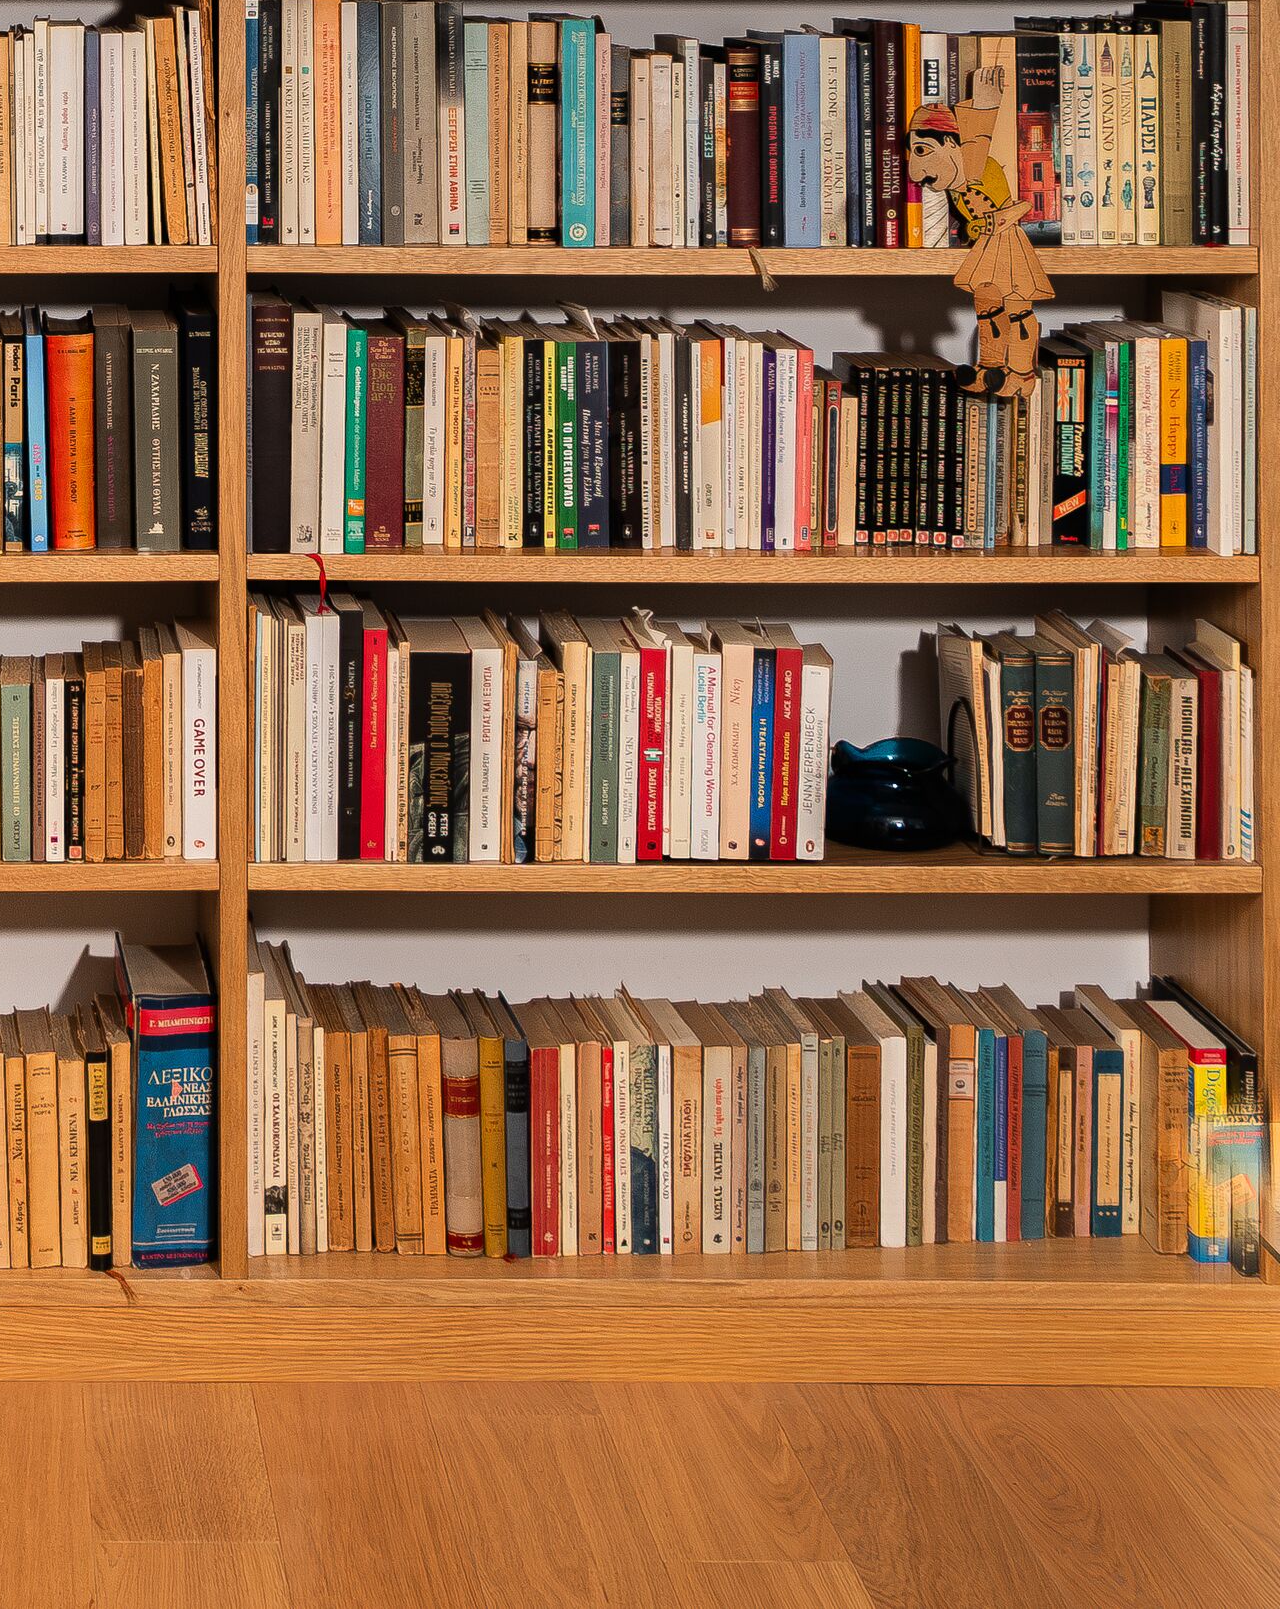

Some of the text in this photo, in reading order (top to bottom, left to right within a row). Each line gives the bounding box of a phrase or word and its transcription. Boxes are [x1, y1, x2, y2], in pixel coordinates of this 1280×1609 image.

[928, 60, 937, 94] PIPER
[1078, 85, 1093, 138] ΡΩΜΗ
[1102, 82, 1115, 151] ΛΟΝΔΙΝΟ
[1142, 97, 1156, 153] ΠΑΡΙΣΙ
[449, 107, 458, 211] ΕΞΕΓΕΡΣΗ ΣΤΗΝ ΑΘΗΝΑ
[10, 376, 20, 406] Paris
[563, 421, 573, 506] ΤΟ ΠΡΟΤΕΚΤΟΡΑΤΟ
[1060, 424, 1073, 475] DICTIONARY
[1074, 424, 1084, 476] Traveller's
[1058, 498, 1080, 514] NEW
[697, 665, 706, 723] Lucia Berlin
[784, 671, 792, 719] ALICE MUNRO
[194, 718, 205, 796] GAME OVER
[705, 666, 715, 816] A Manual for Cleaning Women
[803, 708, 815, 815] JENNY ERPENBECK
[1181, 696, 1192, 837] NICHOLAS ALEXANDRA
[428, 811, 437, 836] GREEN
[146, 1094, 212, 1108] ΕΛΛΗΝΙΚΗΣ
[148, 1067, 212, 1085] ΛΕΞΙΚΟ
[183, 1082, 211, 1093] ΝΕΑΣ
[643, 1070, 653, 1134] ΕΚΣΤΡΑΤΕΙΑ
[163, 1106, 212, 1118] ΓΛΩΣΣΑΣ
[272, 1092, 280, 1177] ΟΙ ΧΑΛΚΟΚΟΝΔΥΛΑΙ
[70, 1114, 78, 1182] ΝΕΑ ΚΕΙΜΕΝΑ
[714, 1143, 722, 1221] ΚΩΣΤΑΣ ΤΑΧΤΣΗΣ
